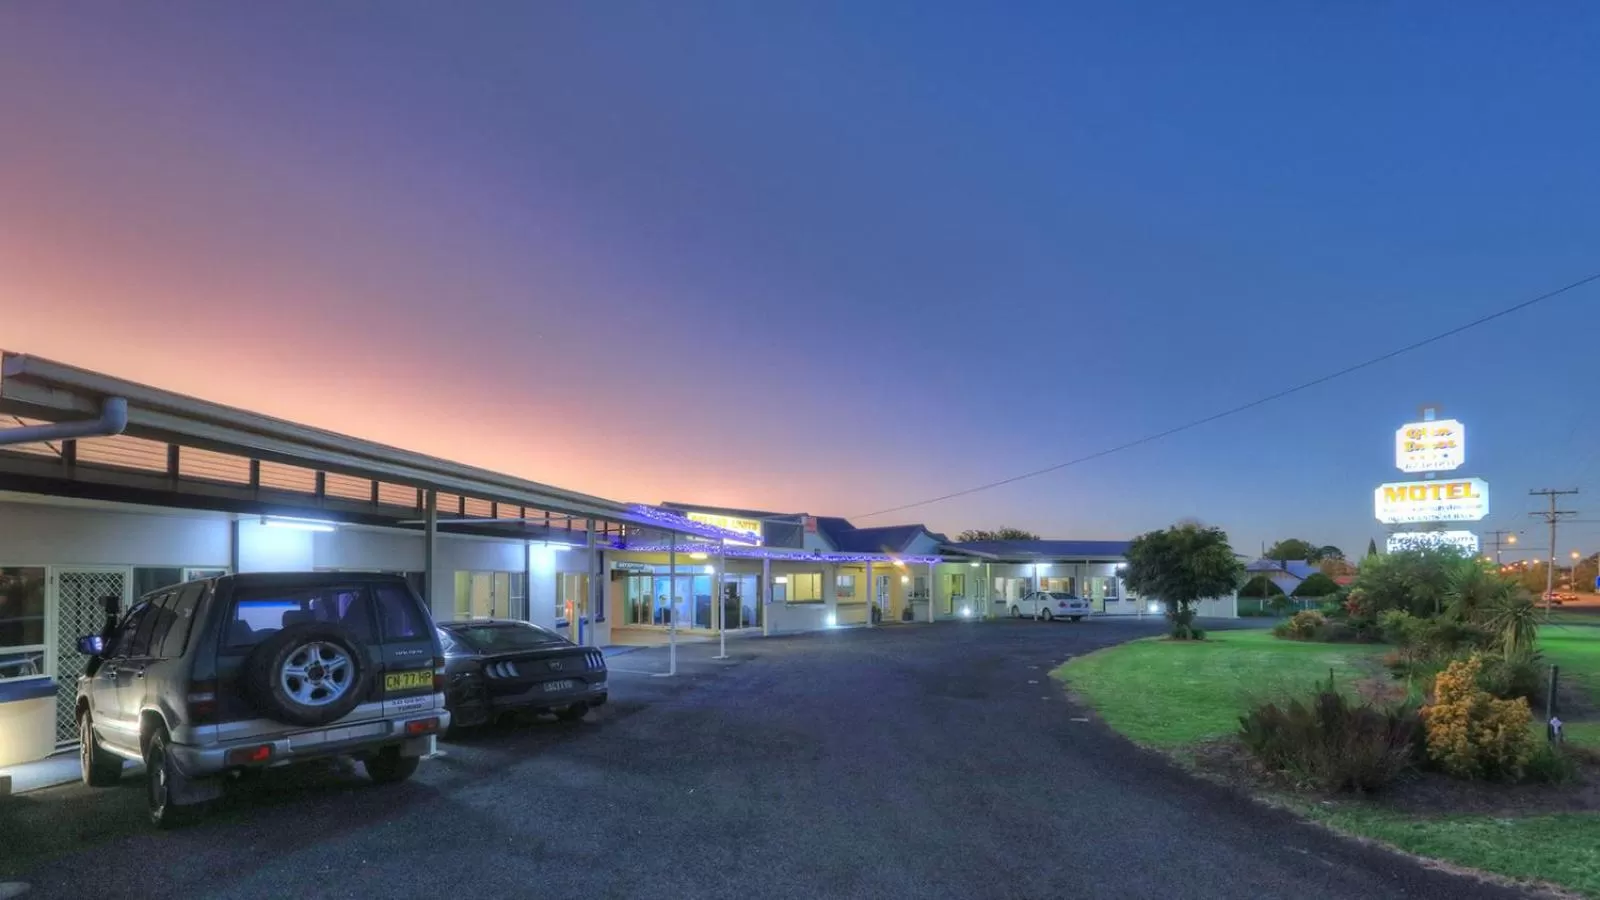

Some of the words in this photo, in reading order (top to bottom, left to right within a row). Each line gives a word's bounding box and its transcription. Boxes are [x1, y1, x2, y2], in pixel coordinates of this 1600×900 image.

[1383, 481, 1480, 502] MOTEL
[386, 675, 401, 688] CN
[403, 673, 416, 685] 77
[418, 671, 432, 684] HP
